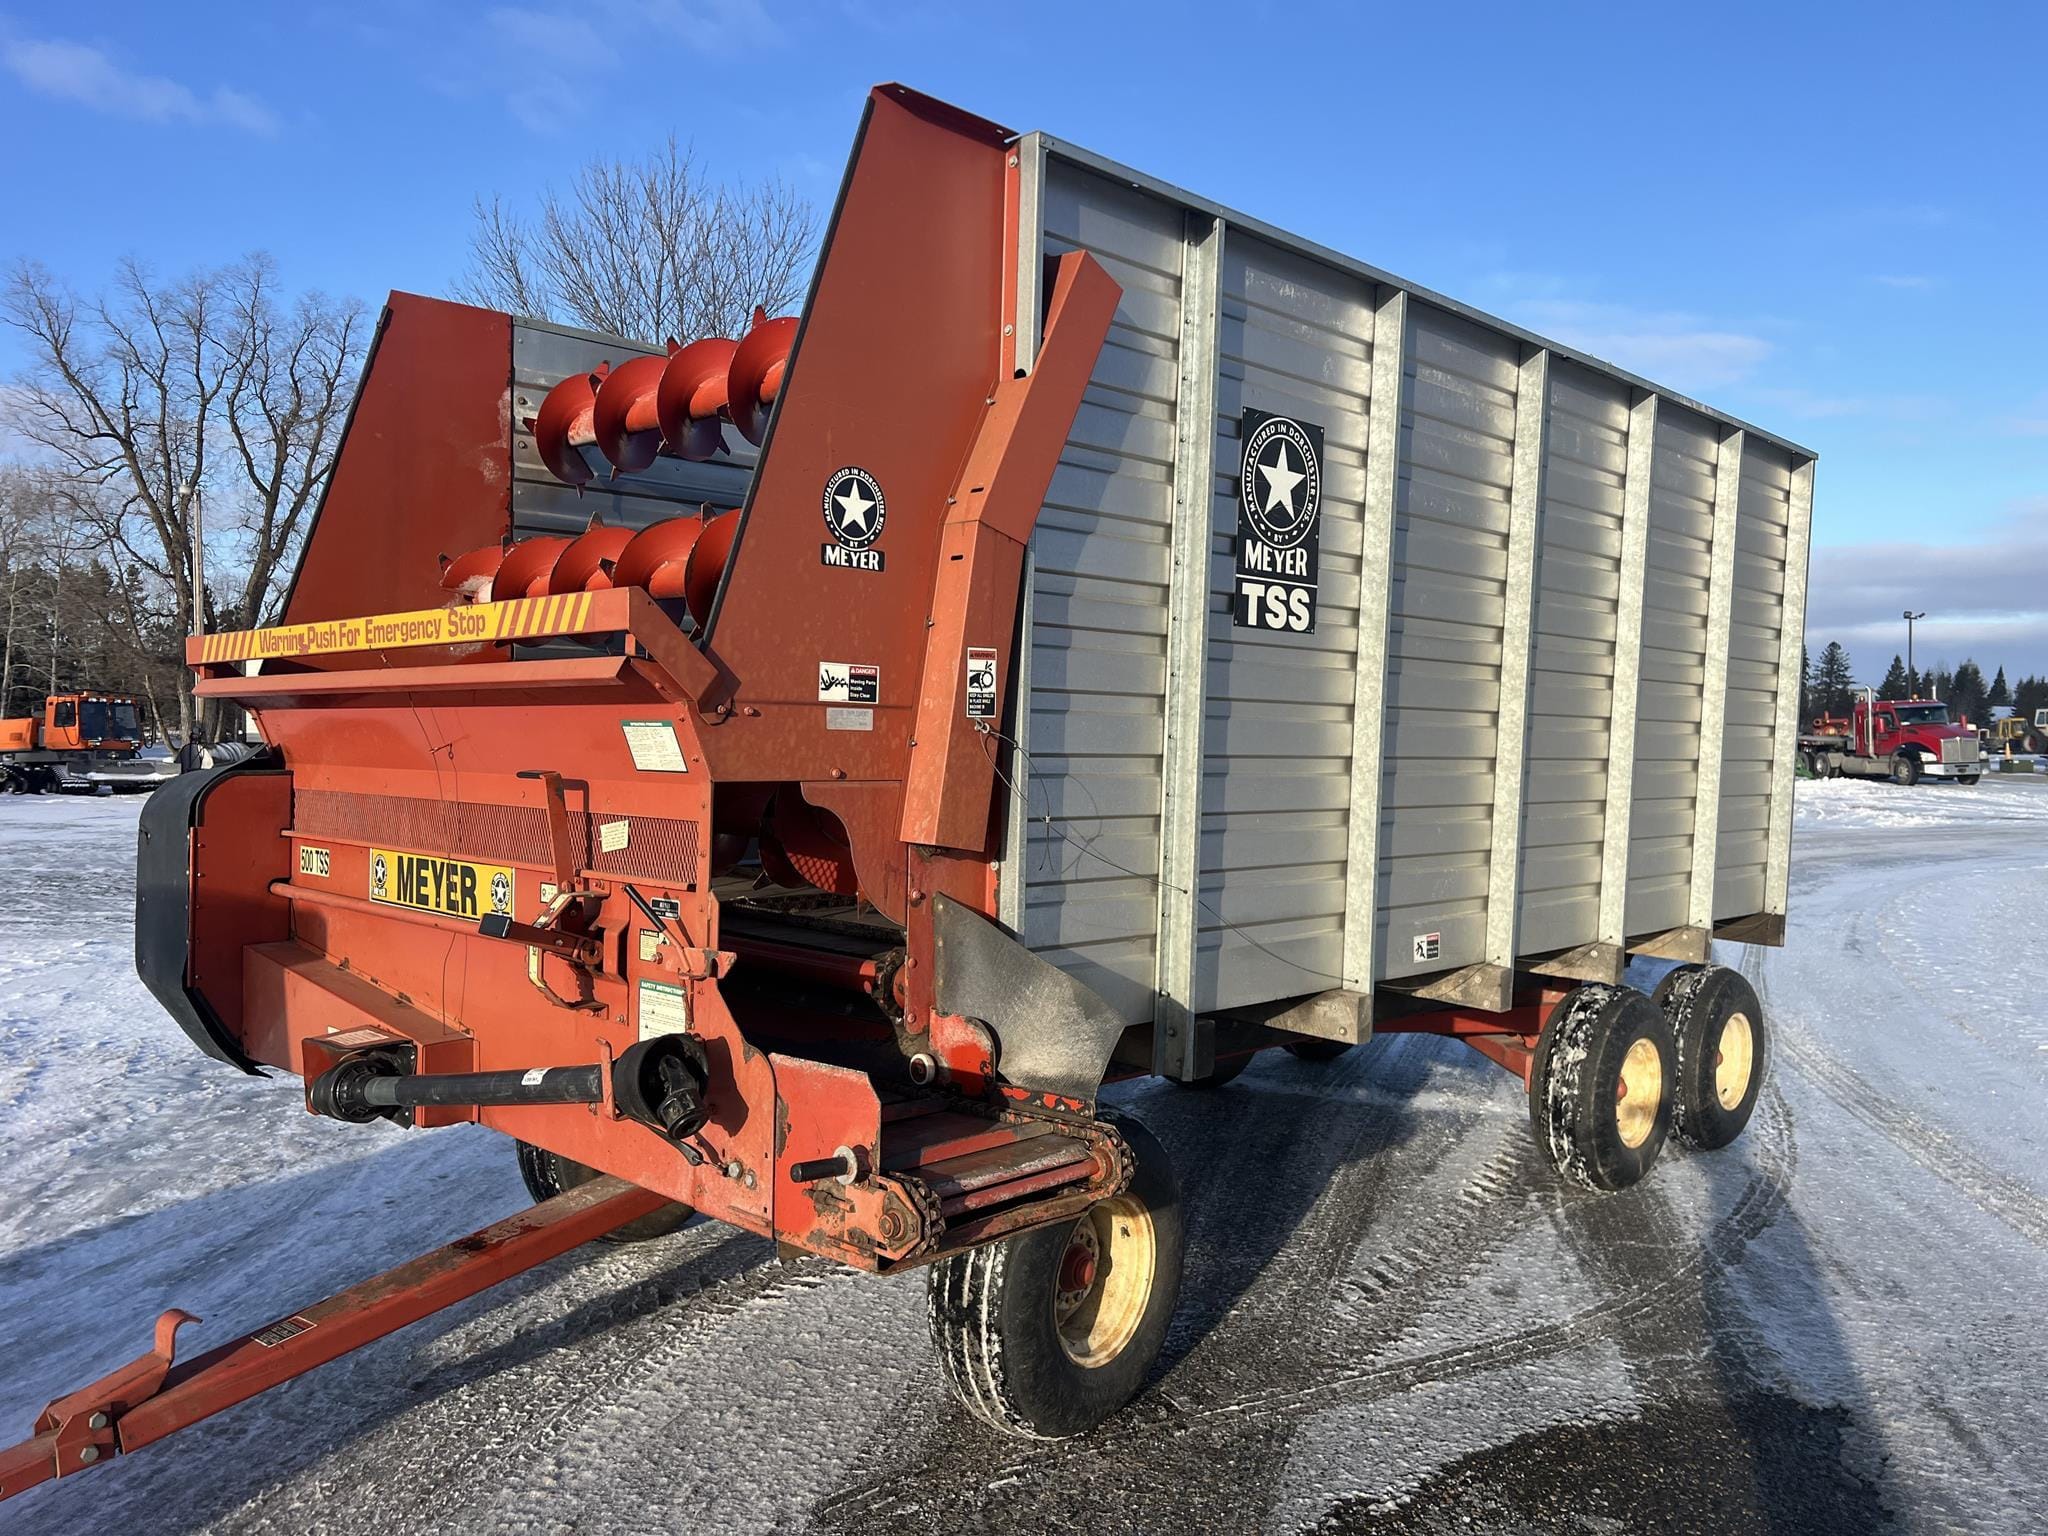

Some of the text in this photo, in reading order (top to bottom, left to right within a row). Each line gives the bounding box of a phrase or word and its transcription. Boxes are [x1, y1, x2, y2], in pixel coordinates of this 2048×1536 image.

[1245, 425, 1276, 513] MANUFACTURED
[1277, 423, 1287, 434] IN
[823, 468, 850, 522] MANUFACTURED
[851, 467, 859, 475] IN
[825, 544, 880, 571] MEYER
[1244, 538, 1308, 577] MEYER
[1241, 582, 1310, 631] TSS
[307, 624, 337, 651] Push
[338, 622, 361, 648] For
[365, 618, 442, 644] Emergency
[447, 608, 486, 638] Stop
[855, 667, 876, 675] DANGER
[302, 848, 329, 875] 500 TSS
[397, 855, 478, 916] MEYER
